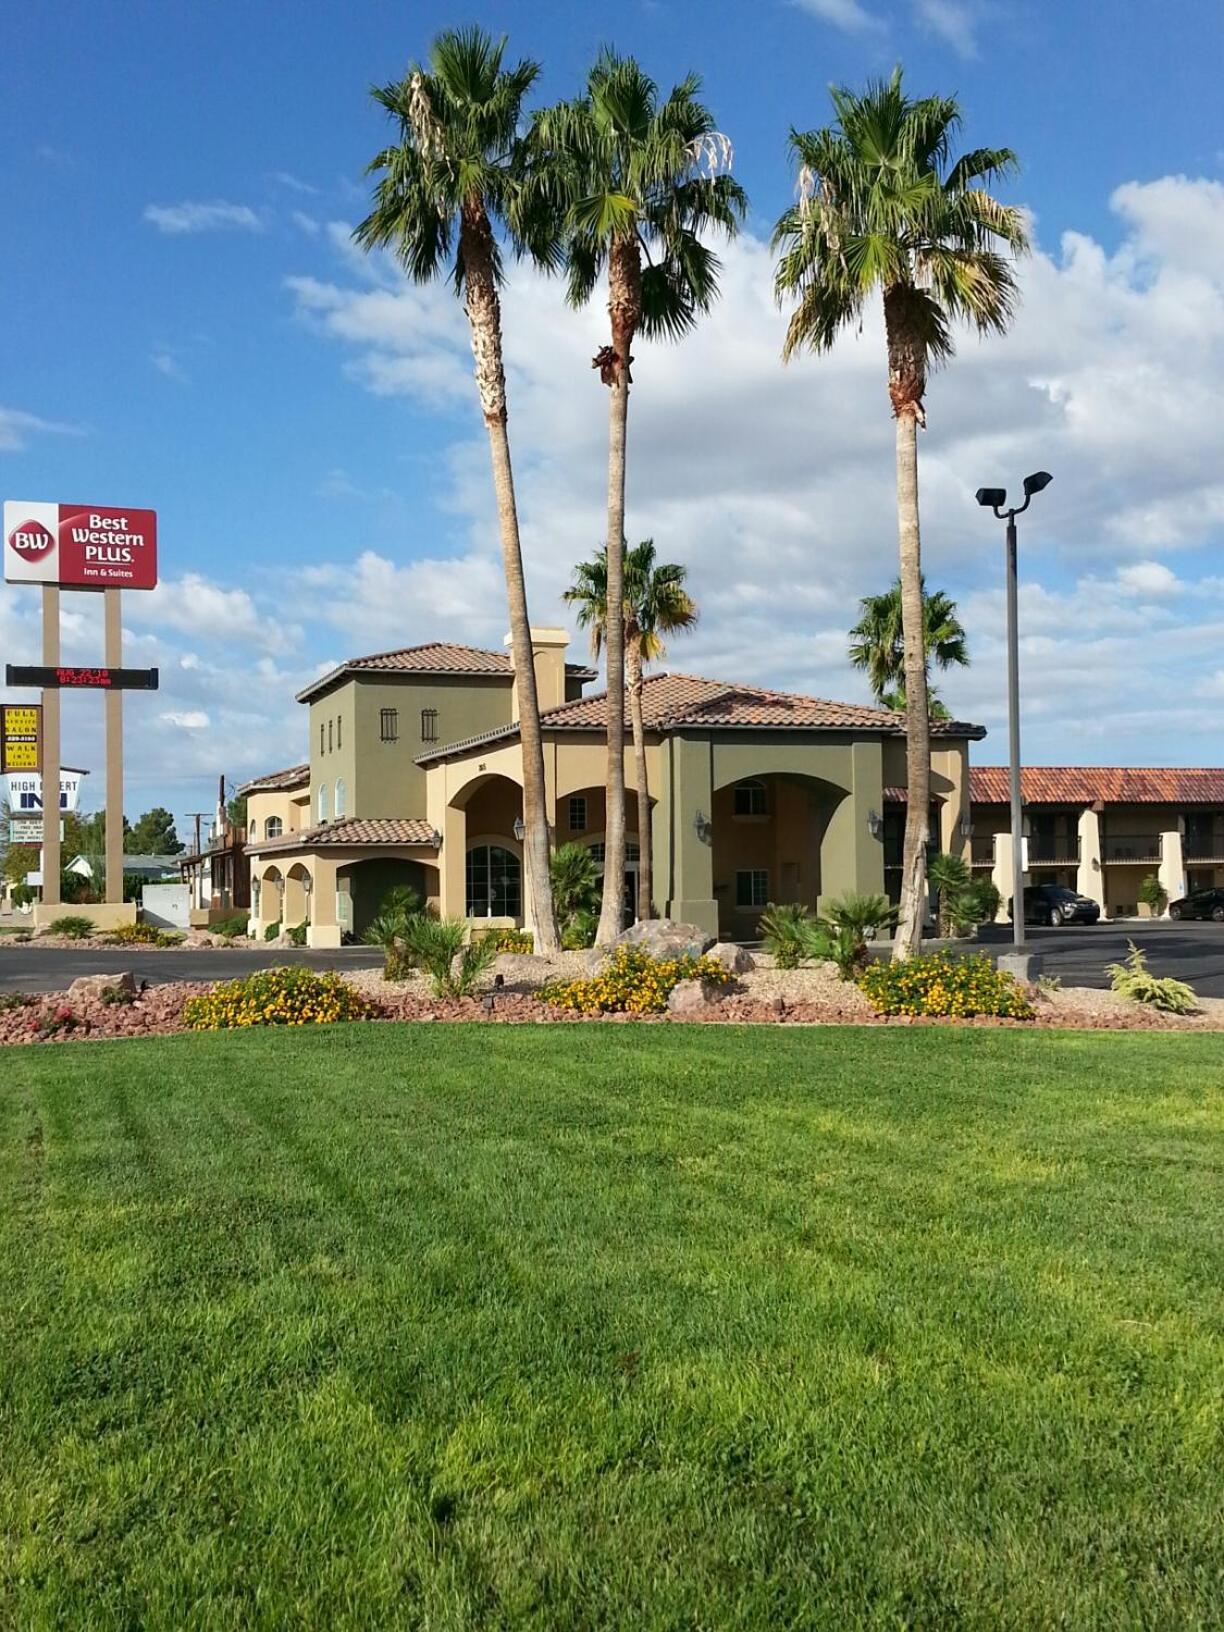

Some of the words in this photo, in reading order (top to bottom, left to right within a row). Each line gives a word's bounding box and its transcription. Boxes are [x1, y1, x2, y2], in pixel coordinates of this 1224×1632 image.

[89, 514, 129, 531] Best
[15, 532, 49, 550] BW
[71, 528, 145, 546] Western
[84, 567, 99, 576] Inn
[99, 568, 108, 576] &
[108, 568, 134, 578] Suites
[11, 781, 36, 791] HIGH
